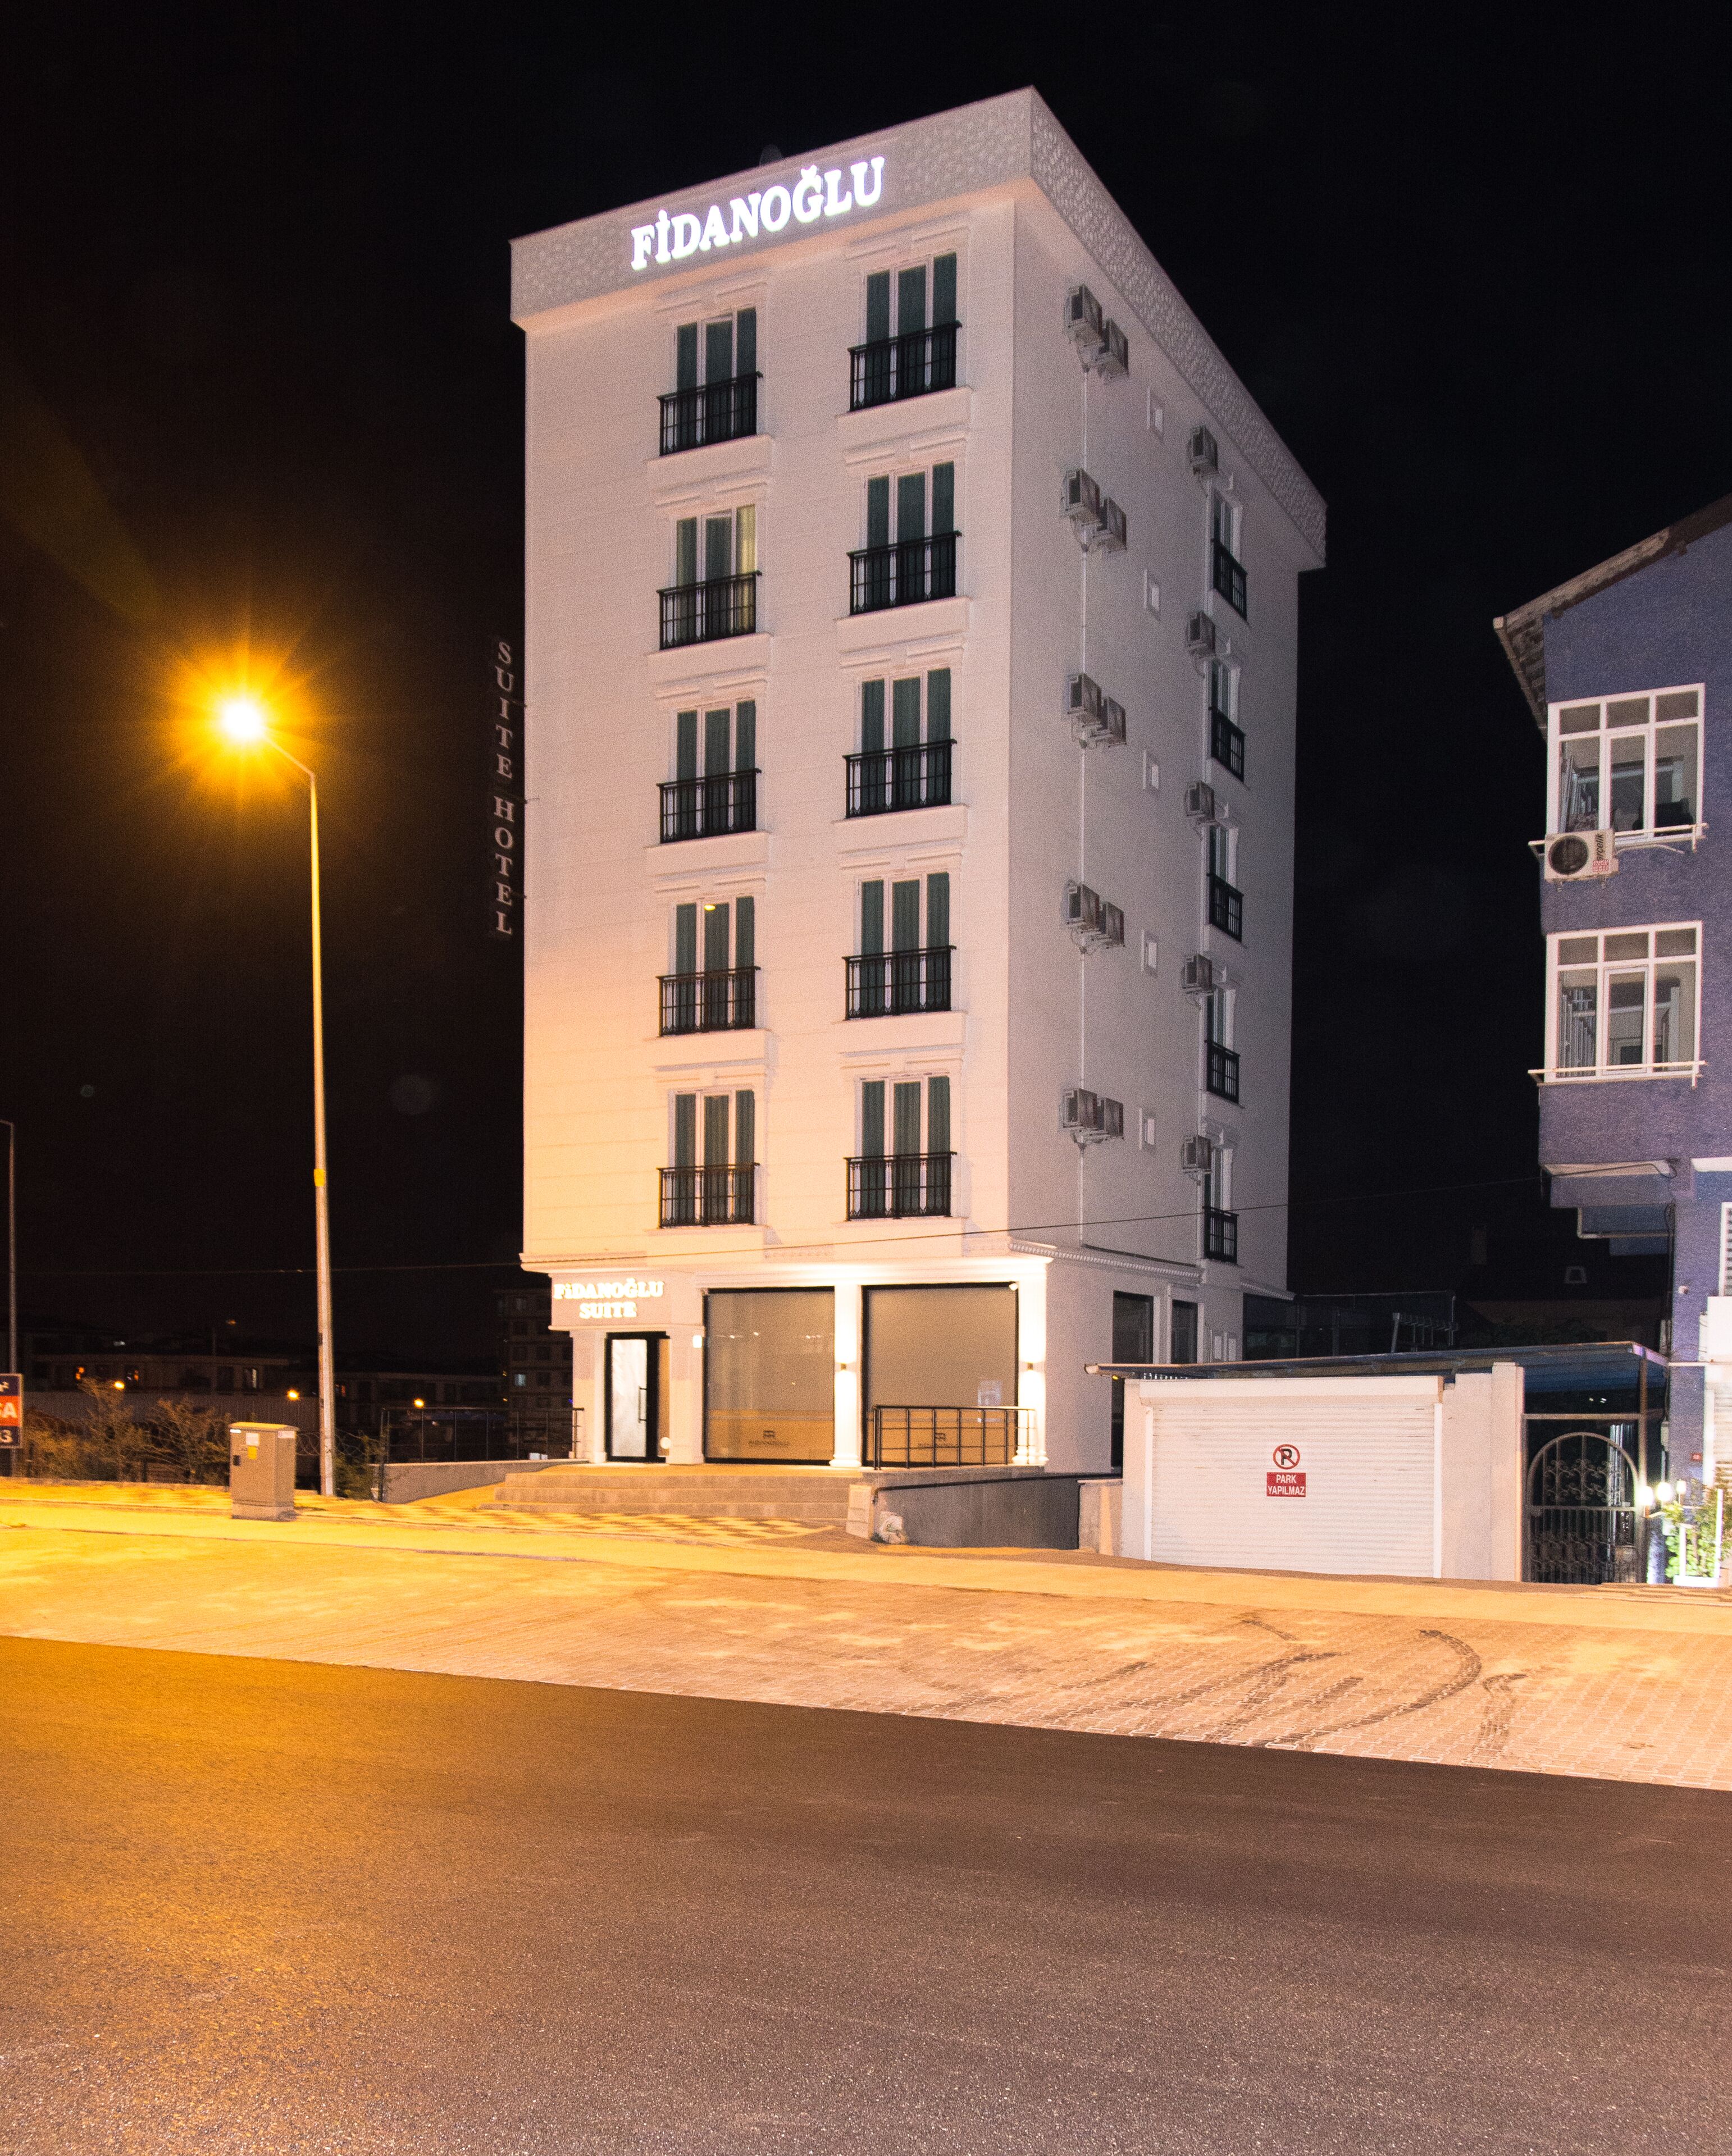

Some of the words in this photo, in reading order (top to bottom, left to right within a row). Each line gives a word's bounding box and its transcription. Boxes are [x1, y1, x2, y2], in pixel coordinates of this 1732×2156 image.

[631, 156, 885, 271] FİDANOĞLU
[494, 641, 513, 779] SUITE
[494, 795, 513, 935] HOTEL
[578, 1301, 637, 1319] SUITE
[0, 1402, 17, 1418] A
[1281, 1449, 1292, 1465] P
[1276, 1474, 1297, 1483] PARK
[1268, 1486, 1305, 1495] YAPILMAZ
